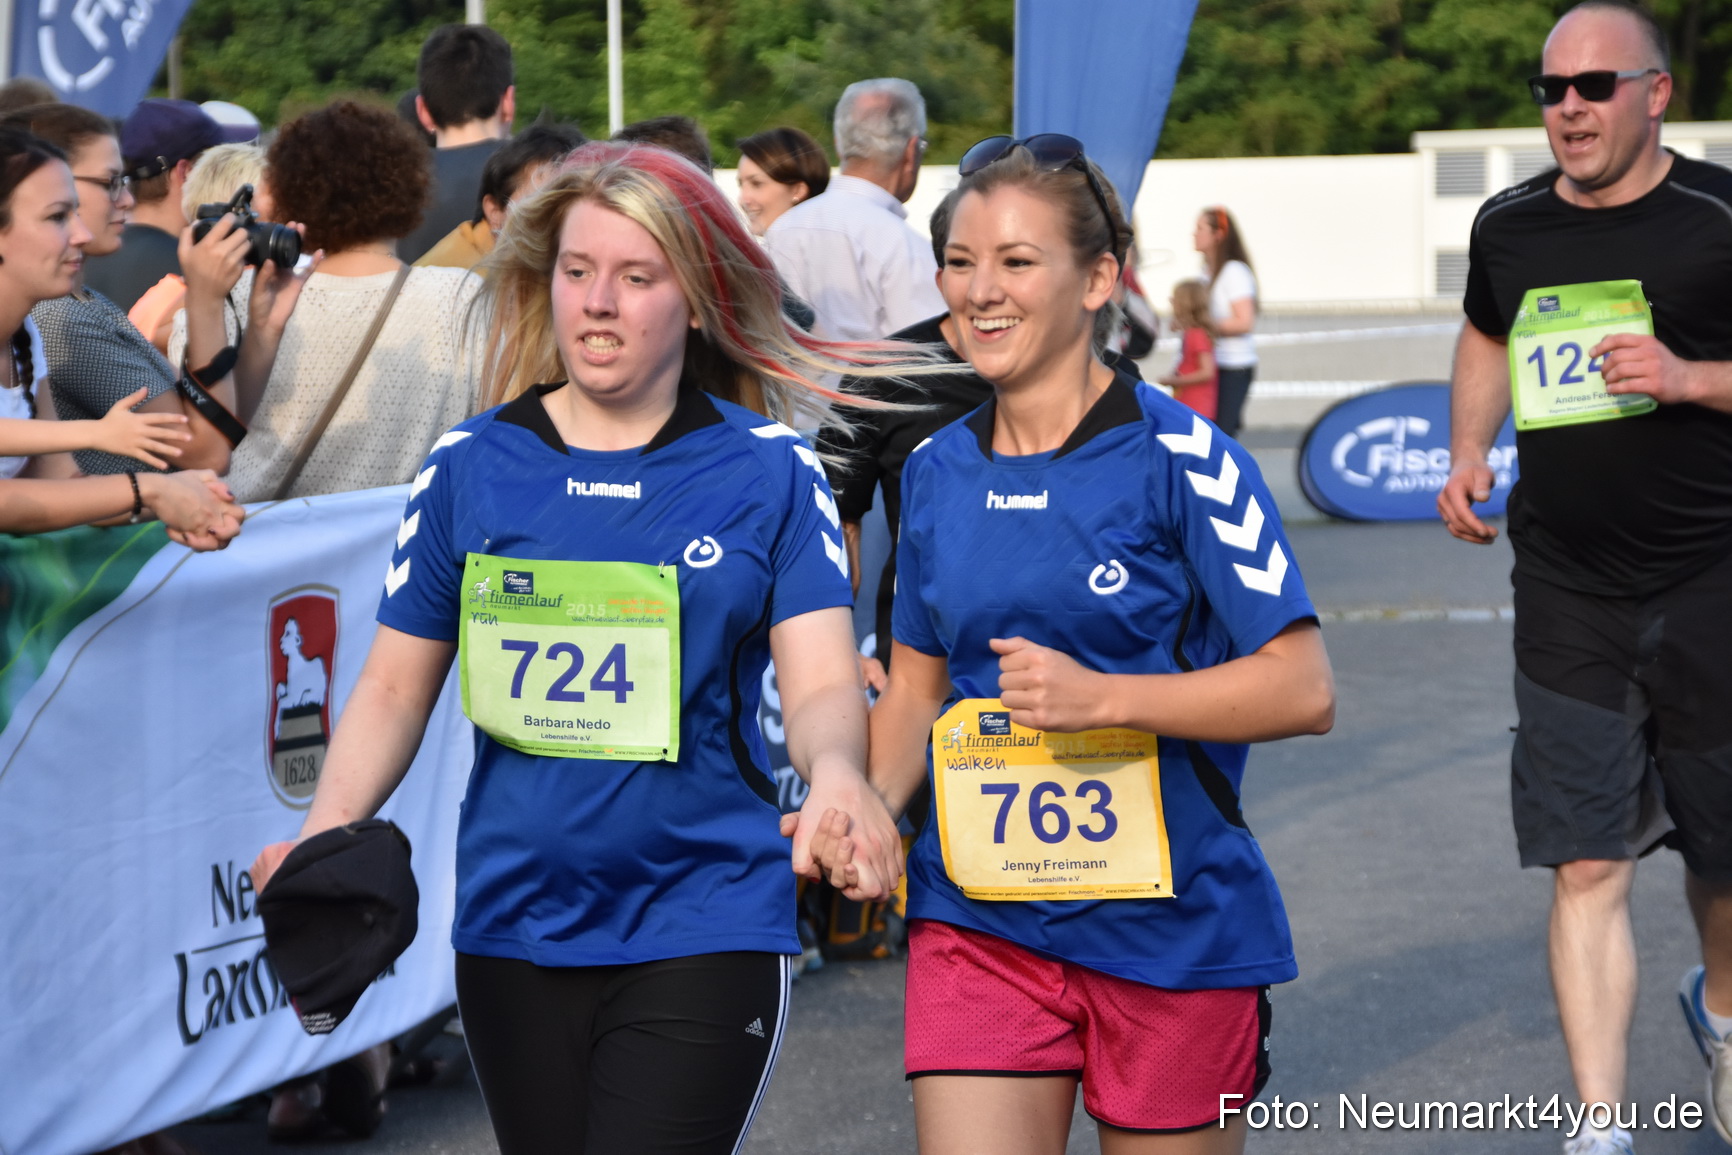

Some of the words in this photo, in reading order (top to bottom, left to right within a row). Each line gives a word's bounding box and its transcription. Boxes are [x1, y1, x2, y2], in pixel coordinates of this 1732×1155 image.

[1556, 395, 1592, 404] Andreas
[1367, 444, 1518, 479] Fiscer
[567, 477, 641, 499] hummel
[986, 489, 1049, 509] hummel
[490, 589, 563, 608] firmenlauf
[566, 602, 607, 617] 2015
[501, 639, 634, 704] 724
[523, 715, 574, 729] Barbara
[576, 718, 611, 730] Nedo
[540, 733, 579, 741] Lebenshilfe
[967, 732, 1042, 747] firmenlauf
[1045, 740, 1086, 754] 2015
[283, 754, 317, 787] 1628
[946, 755, 1007, 771] walken
[981, 780, 1118, 844] 763
[1002, 860, 1041, 873] Jenny
[1043, 859, 1107, 871] Freimann
[745, 1027, 765, 1038] adidas
